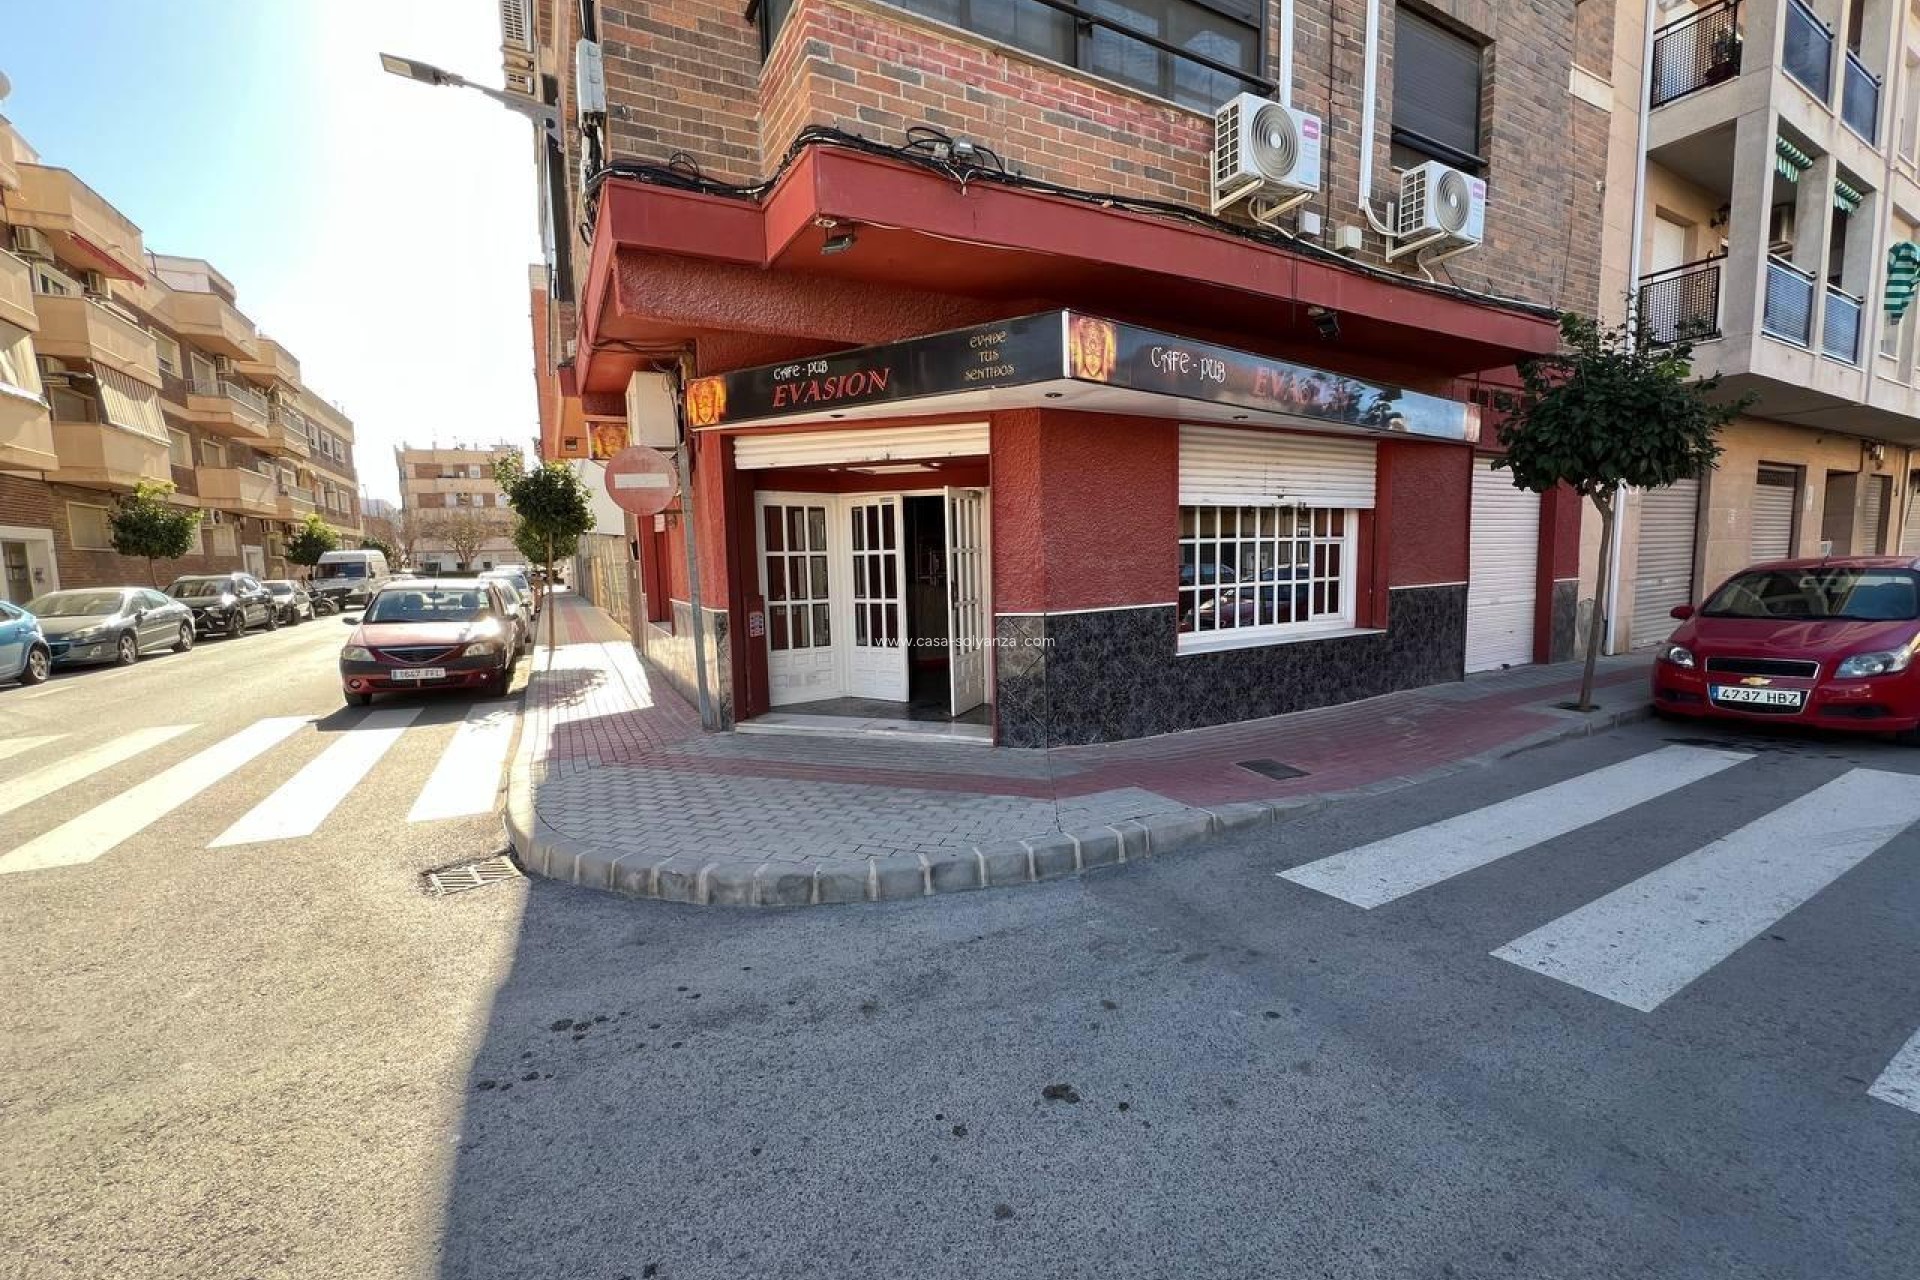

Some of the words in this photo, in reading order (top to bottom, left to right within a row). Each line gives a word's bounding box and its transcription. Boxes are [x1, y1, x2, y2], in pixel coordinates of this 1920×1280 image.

[773, 366, 891, 408] EVASION
[1721, 688, 1760, 702] 4737
[1766, 692, 1798, 704] HBZ
